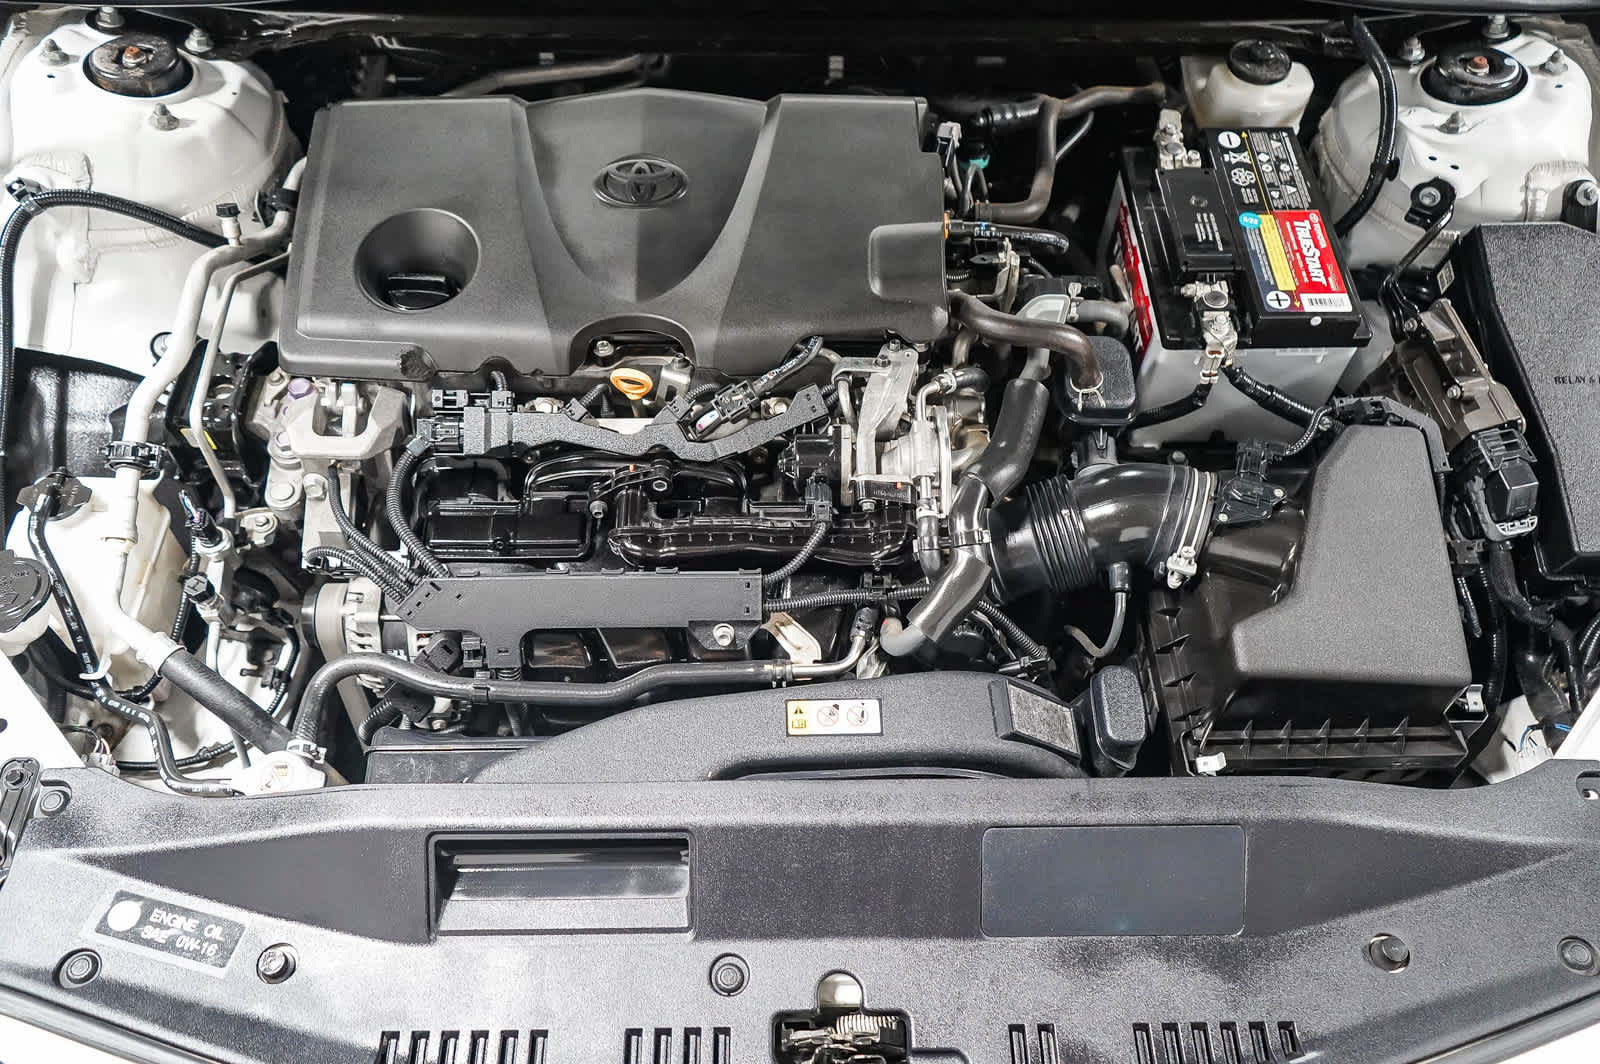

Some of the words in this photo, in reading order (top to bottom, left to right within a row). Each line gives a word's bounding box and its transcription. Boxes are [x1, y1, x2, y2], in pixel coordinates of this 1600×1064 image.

[1553, 375, 1586, 385] RELAY
[140, 924, 168, 945] SAE
[175, 935, 220, 957] 0W-16
[149, 907, 200, 933] ENGINE
[203, 923, 225, 943] OIL
